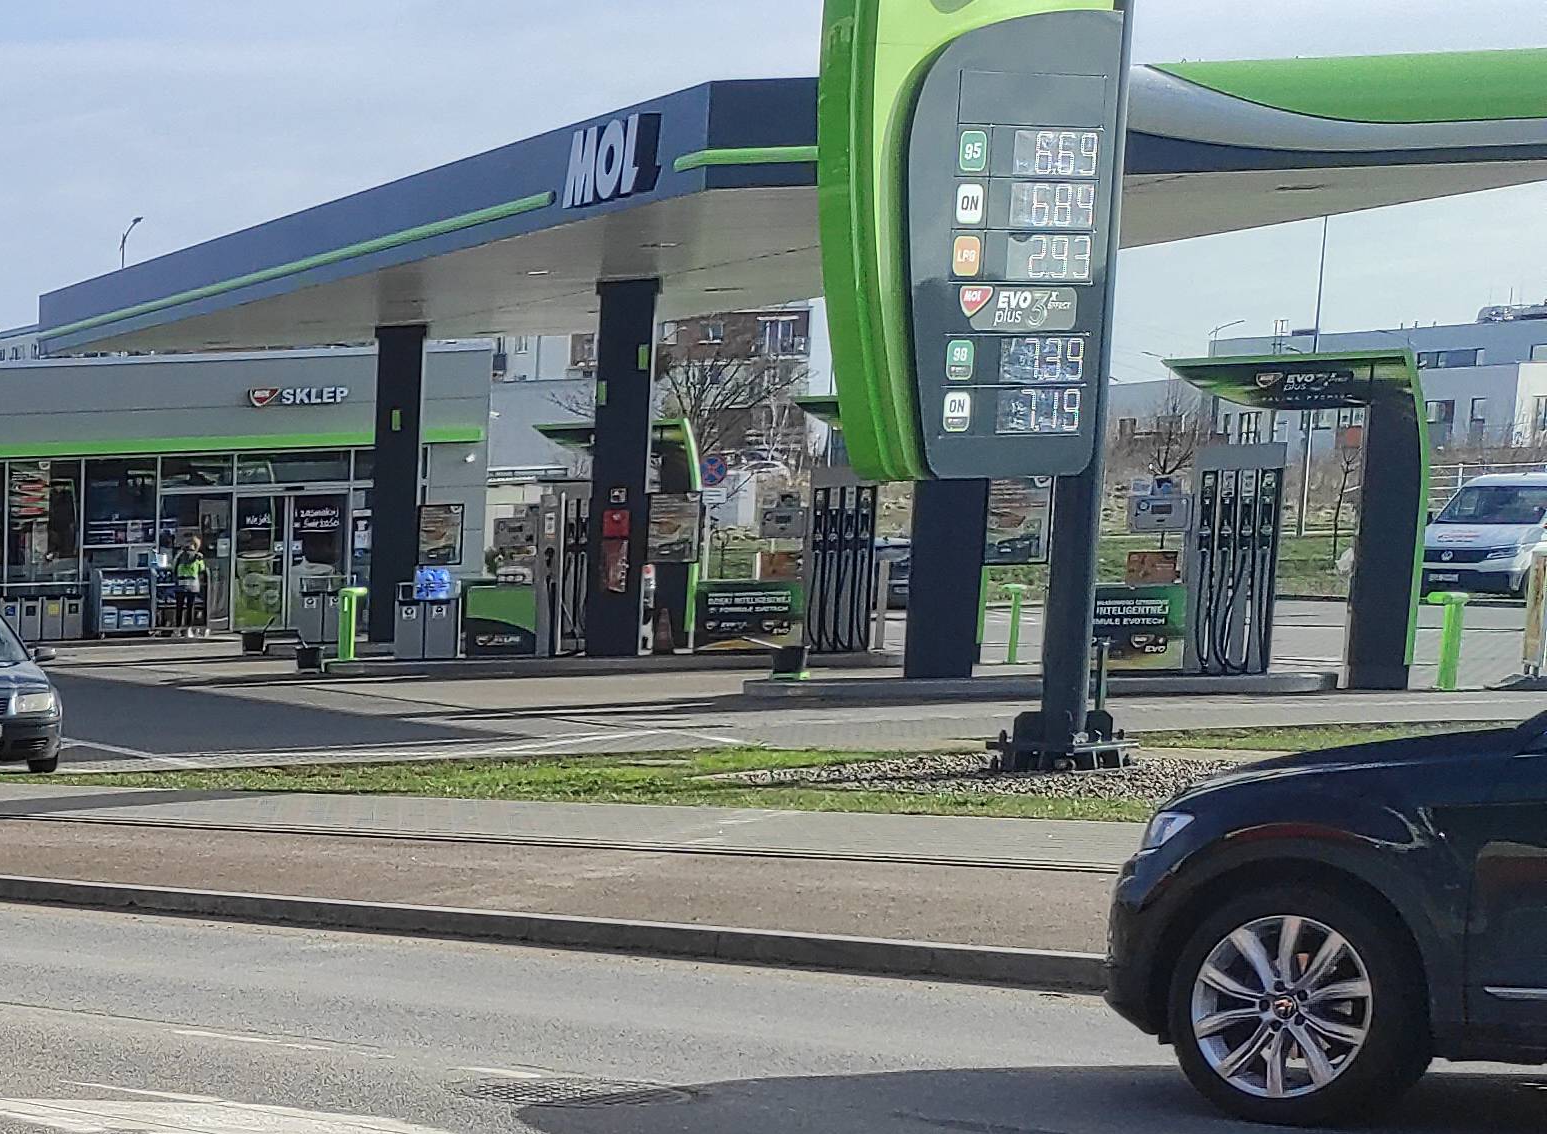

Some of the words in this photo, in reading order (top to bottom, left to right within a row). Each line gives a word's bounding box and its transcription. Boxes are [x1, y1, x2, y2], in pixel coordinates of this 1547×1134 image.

[964, 143, 983, 159] 95
[563, 113, 639, 209] MOL
[961, 195, 979, 211] ON
[963, 290, 982, 301] MOL
[997, 291, 1032, 308] EVO
[993, 309, 1023, 327] plus
[953, 347, 968, 361] 98
[1287, 374, 1314, 384] EVO
[281, 386, 349, 405] SKLEP
[949, 400, 965, 413] ON
